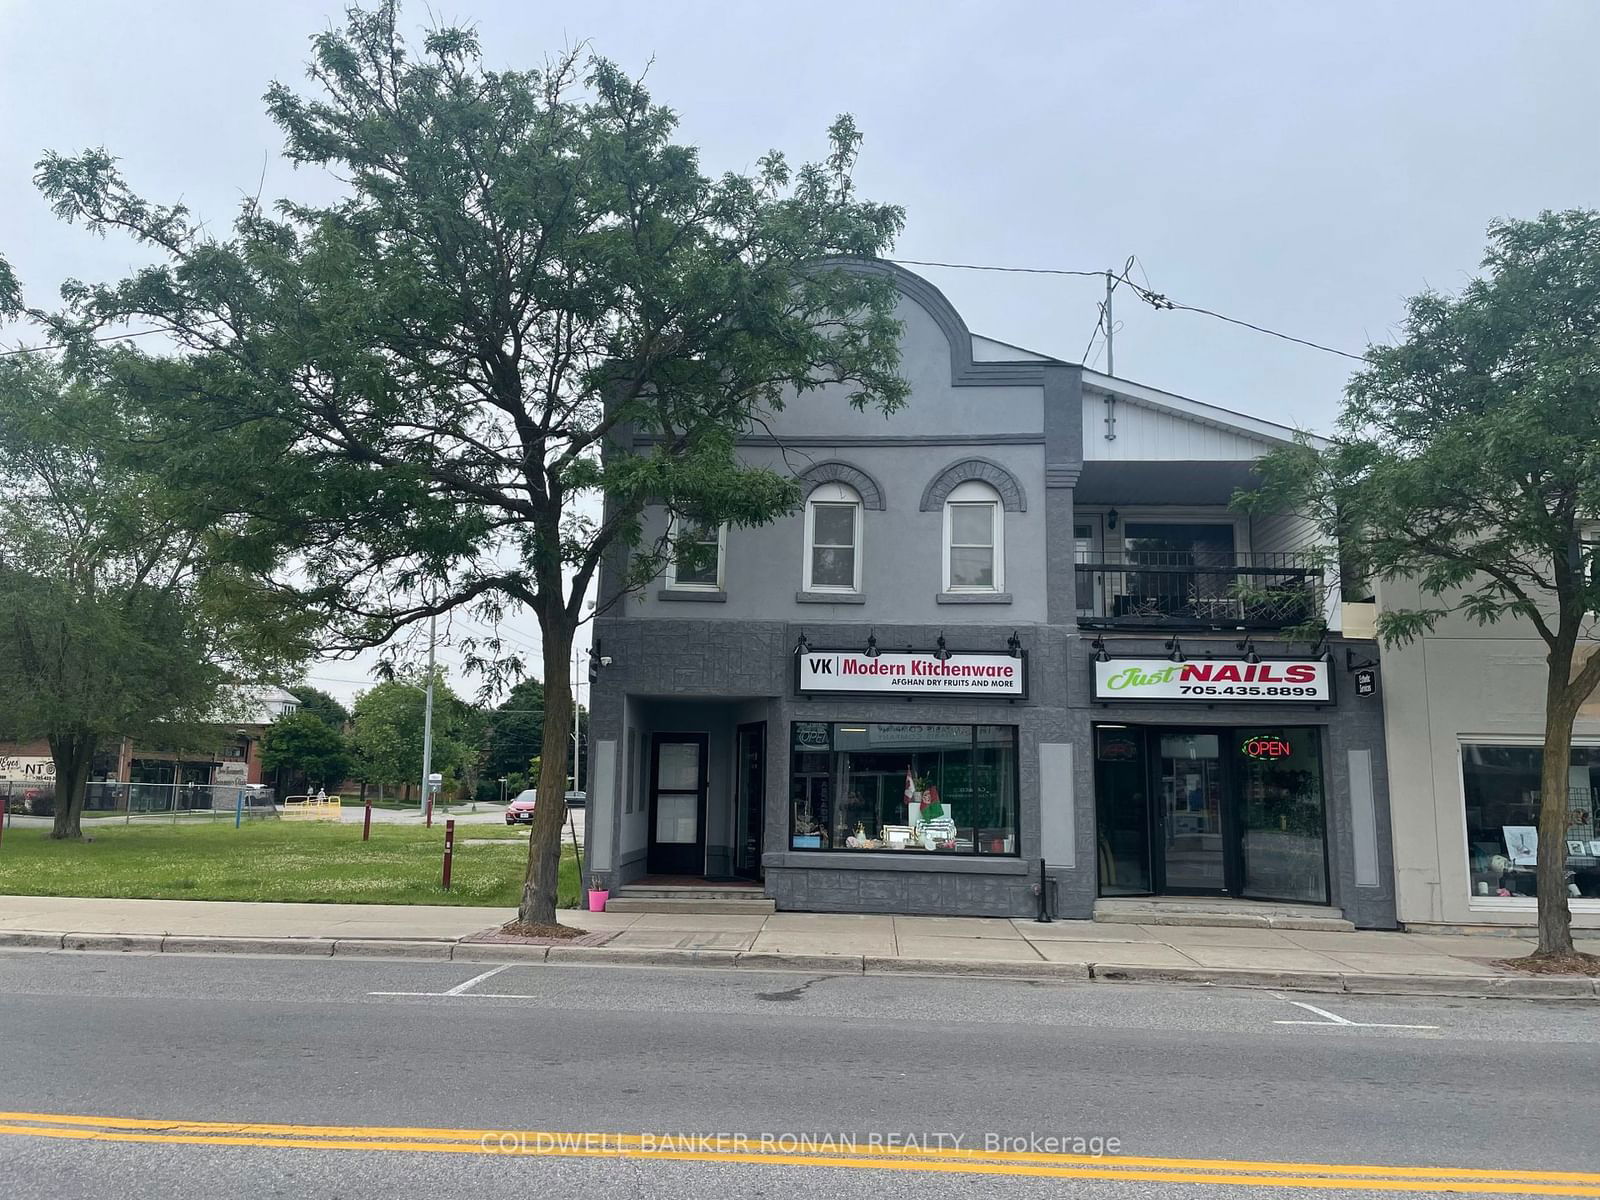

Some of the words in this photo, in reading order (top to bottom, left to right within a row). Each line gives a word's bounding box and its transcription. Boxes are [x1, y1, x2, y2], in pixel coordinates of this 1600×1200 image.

[809, 658, 833, 675] VK
[842, 658, 906, 676] Modern
[911, 660, 1014, 678] Kitchenware
[891, 678, 924, 687] AFGHAN
[926, 679, 942, 687] DRY
[943, 679, 969, 688] FRUITS
[971, 680, 989, 688] AND
[991, 680, 1014, 688] MORE
[1106, 665, 1178, 690] Just
[1179, 664, 1317, 683] NAILS
[1179, 685, 1318, 697] 705.435.8899
[1248, 741, 1290, 756] OPEN
